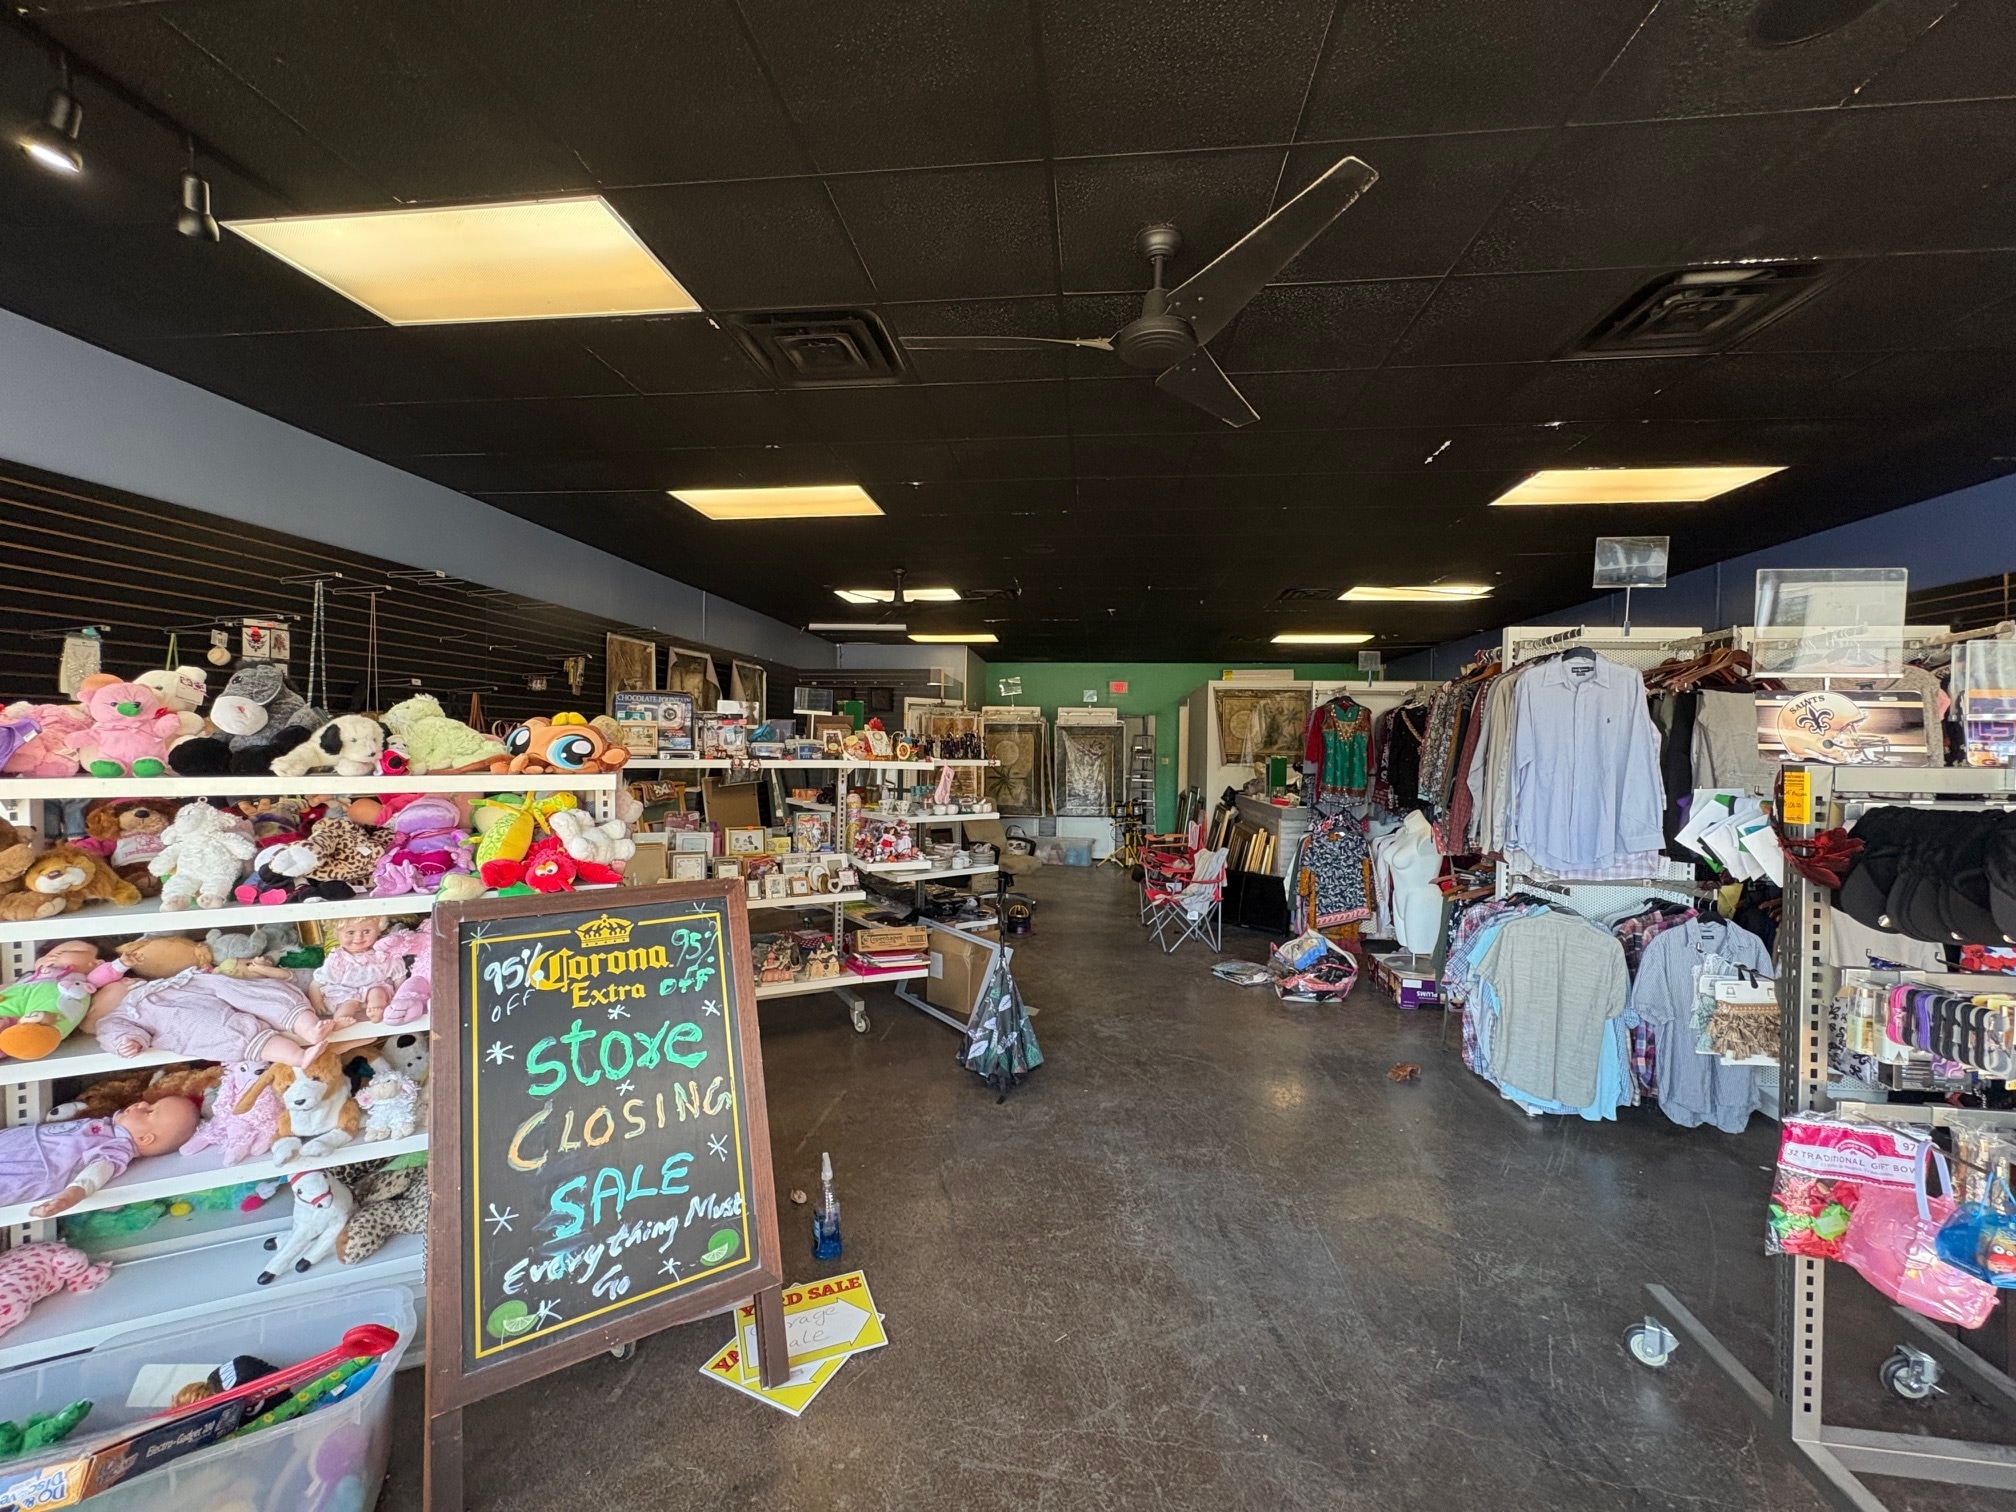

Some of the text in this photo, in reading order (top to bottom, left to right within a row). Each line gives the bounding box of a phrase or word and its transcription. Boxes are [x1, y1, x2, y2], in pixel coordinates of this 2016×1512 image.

[616, 694, 692, 703] CHOCOLATE FOUNTAIN
[1789, 695, 1825, 715] SAINTS
[671, 928, 719, 967] 95%
[484, 942, 545, 995] 95%
[530, 945, 670, 993] Corona
[490, 988, 536, 1022] OFF
[570, 980, 647, 1009] Extra
[508, 1076, 732, 1171] CLOSING
[1802, 1152, 1865, 1167] TRADITIONAL
[1871, 1162, 1890, 1170] GIFT
[547, 1152, 694, 1243] SALE
[503, 1192, 745, 1295] Everything Must
[592, 1264, 631, 1300] Go
[739, 1276, 862, 1318] YD SALE
[789, 1330, 829, 1348] ale
[22, 1483, 66, 1508] DO &
